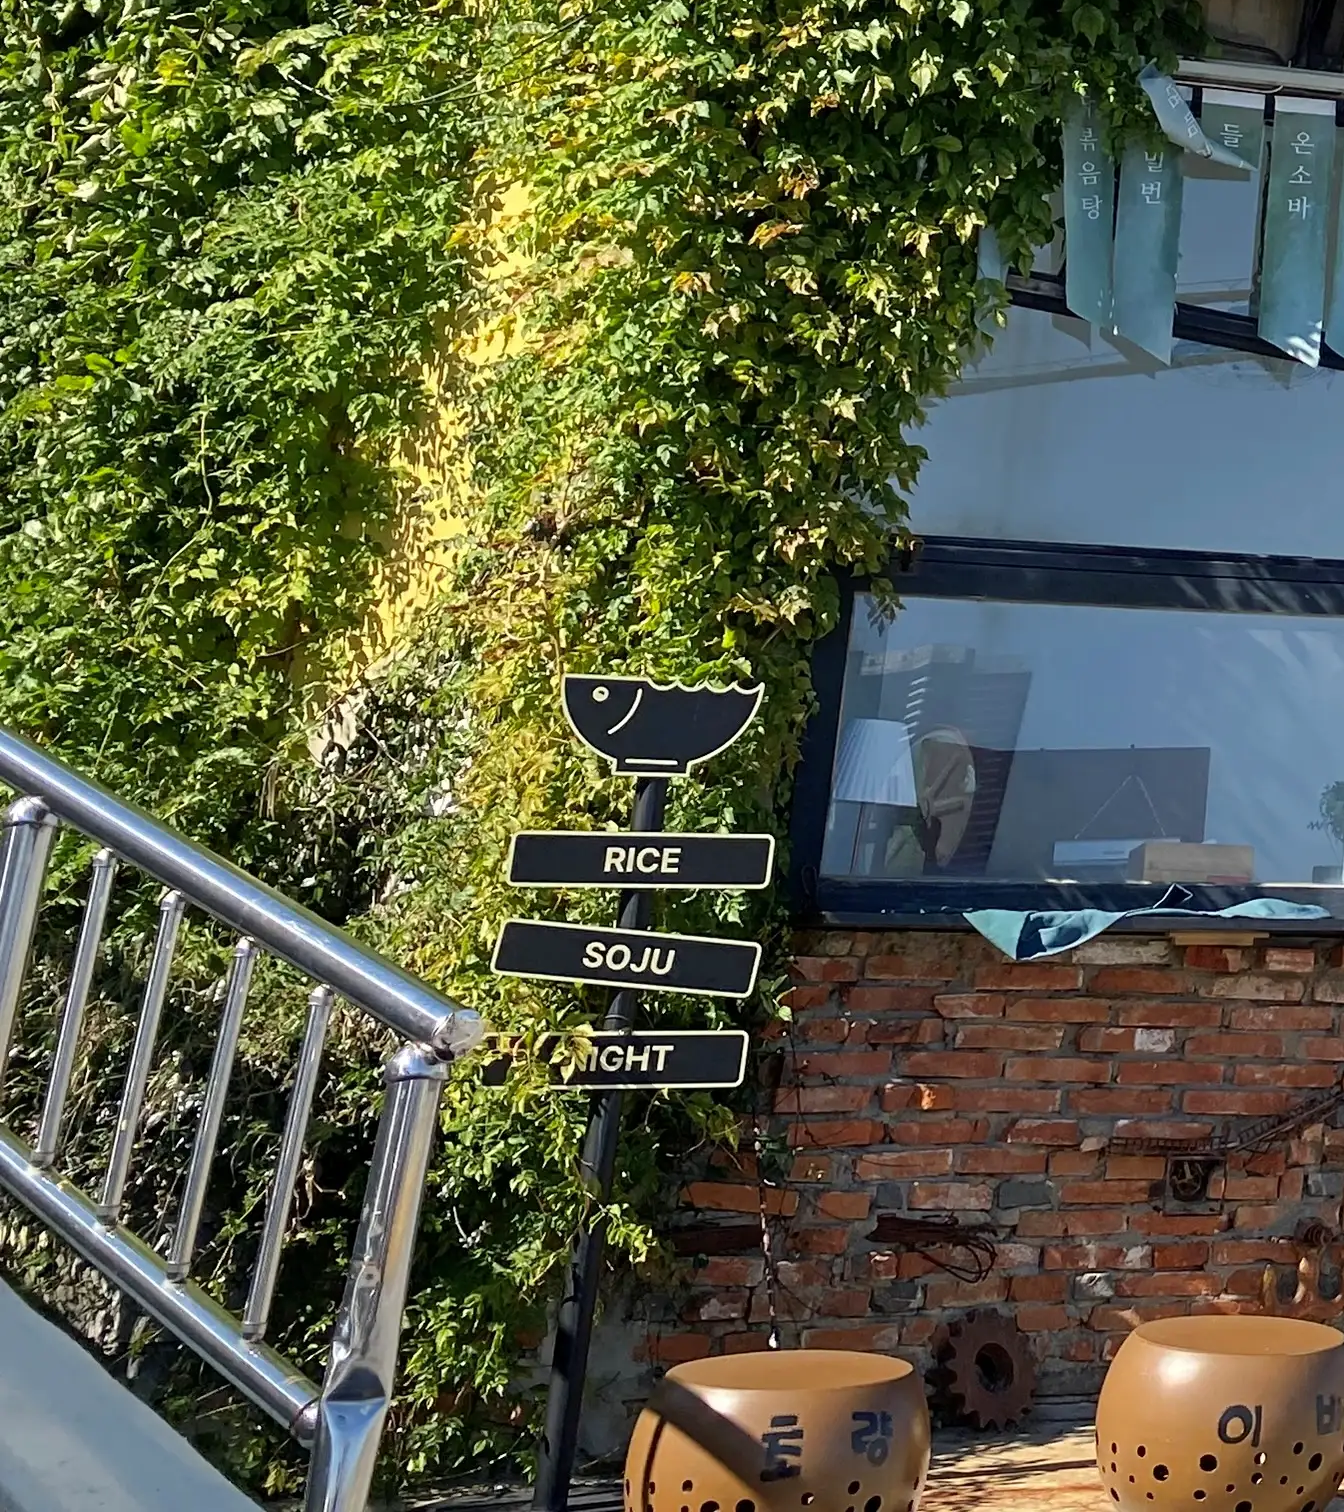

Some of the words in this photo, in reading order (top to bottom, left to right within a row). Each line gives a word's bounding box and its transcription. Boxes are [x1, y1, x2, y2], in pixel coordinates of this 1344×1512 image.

[1288, 131, 1315, 220] 온소바
[602, 846, 683, 875] RICE
[582, 941, 676, 976] SOJU
